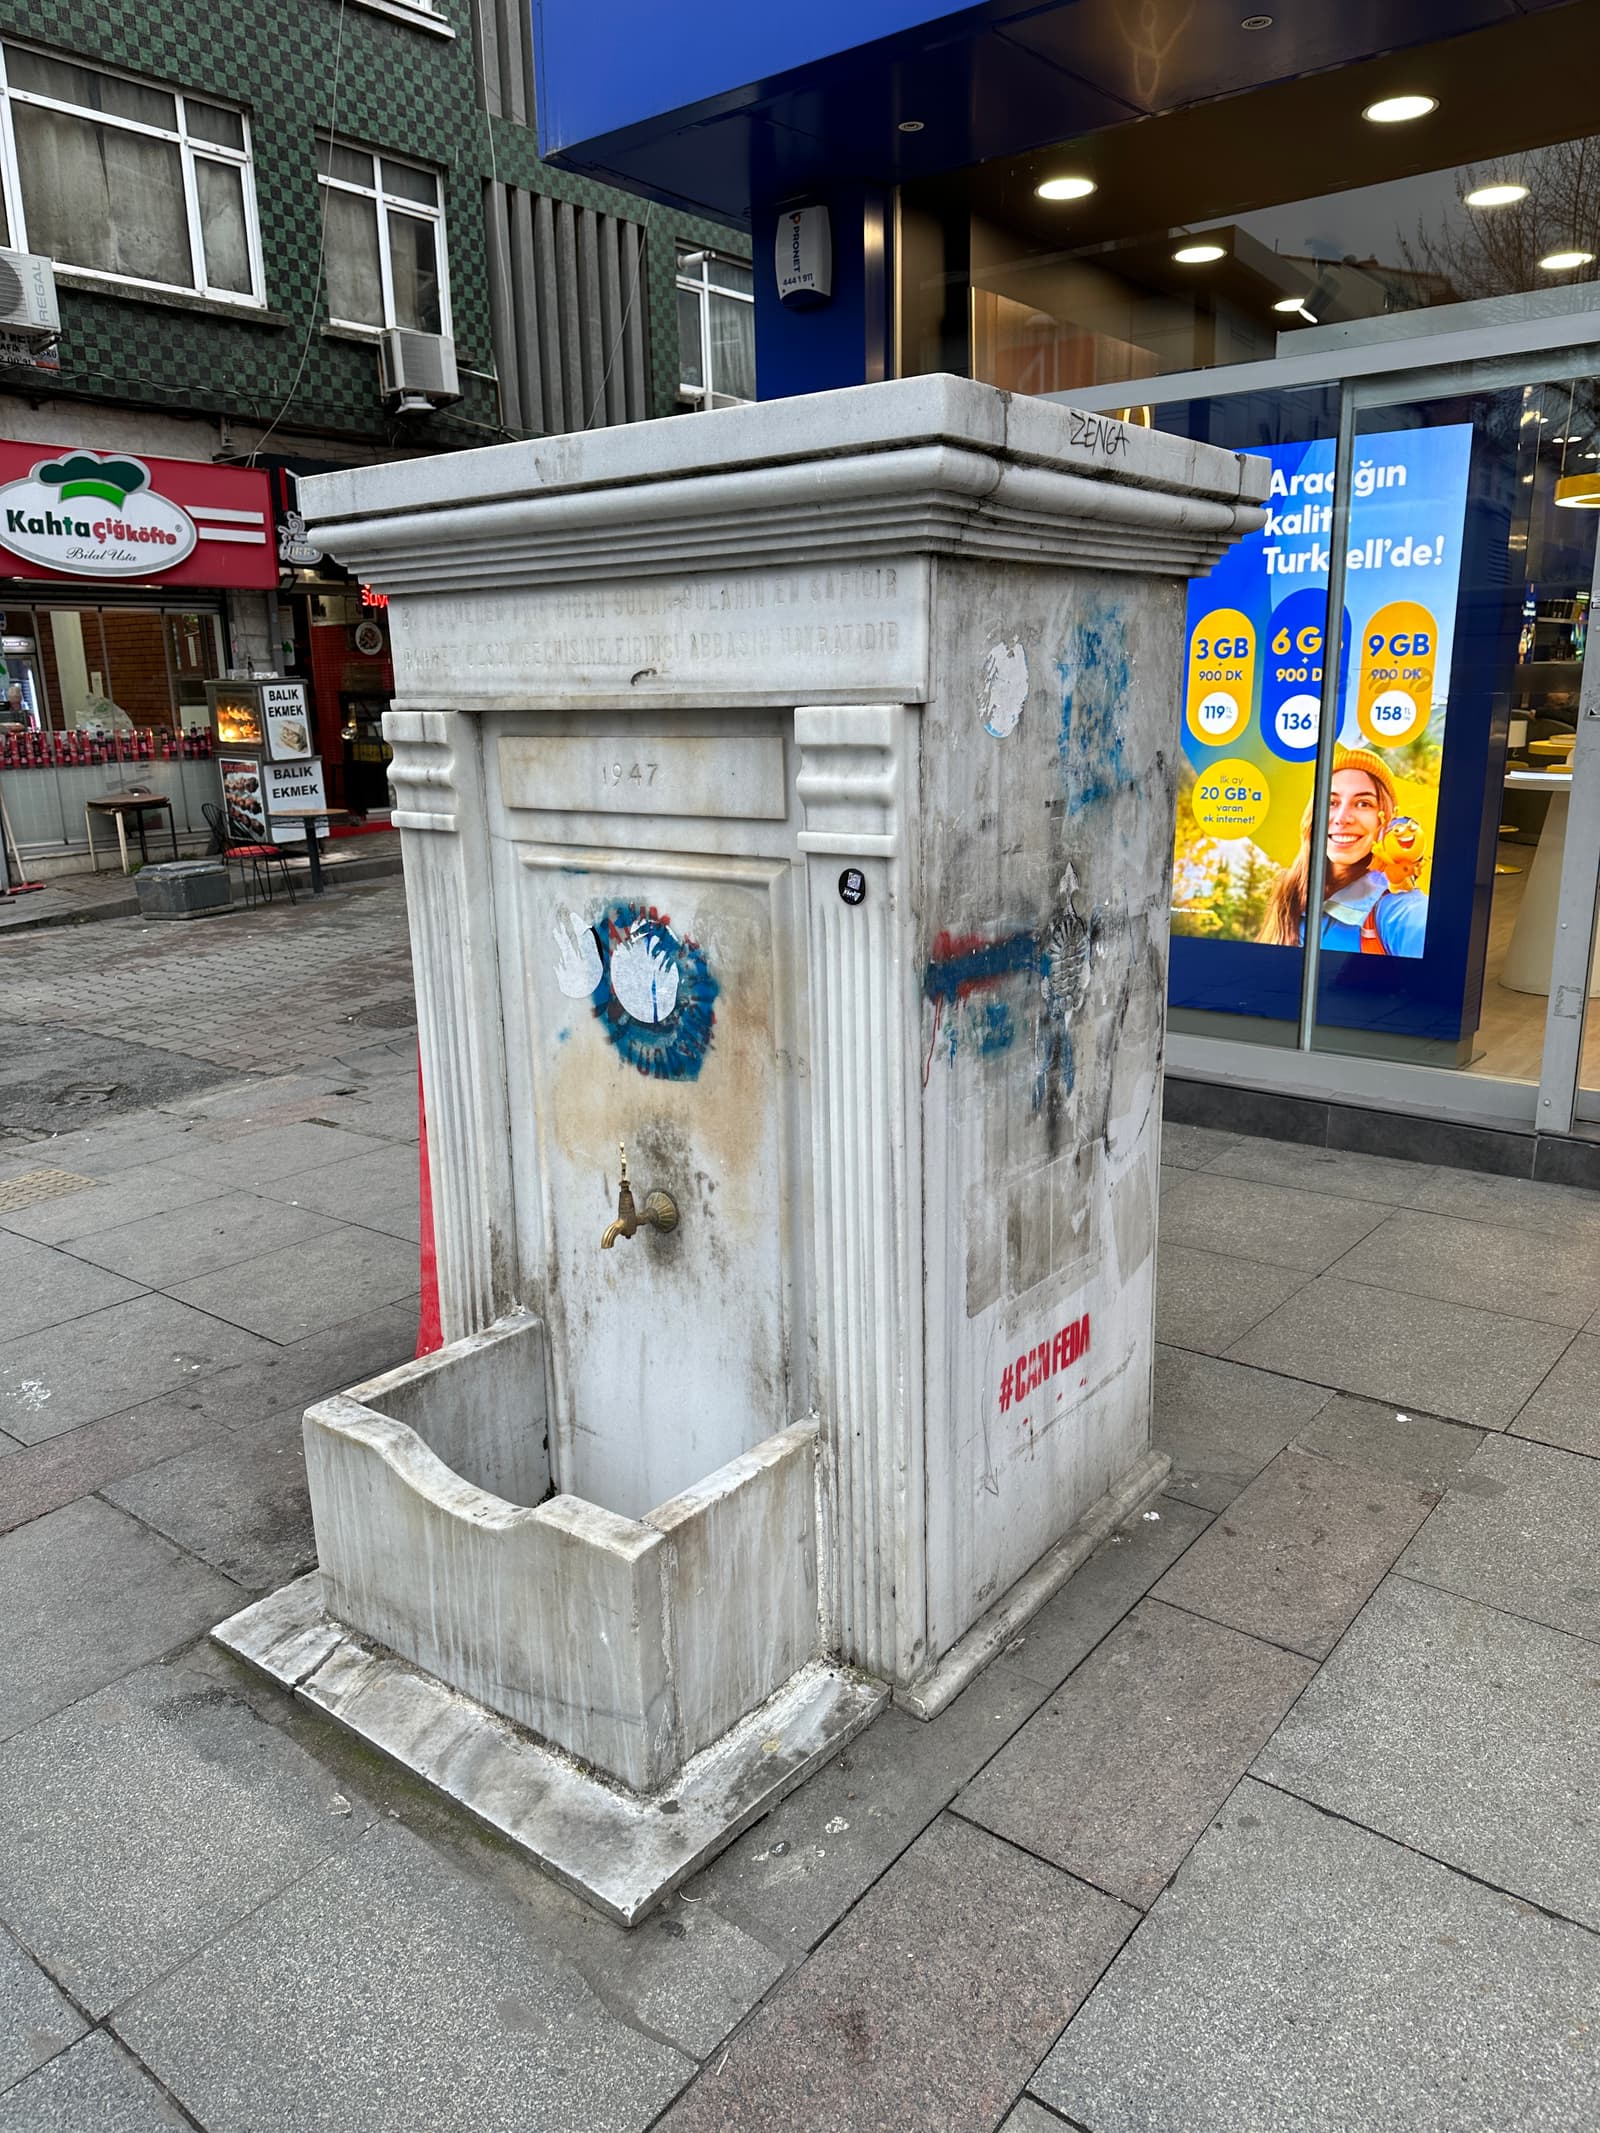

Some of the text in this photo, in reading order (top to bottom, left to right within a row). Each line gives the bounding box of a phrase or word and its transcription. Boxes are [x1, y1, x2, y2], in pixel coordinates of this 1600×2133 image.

[792, 225, 801, 273] PRONET
[783, 276, 797, 286] 444
[32, 261, 49, 322] REGAL
[1070, 411, 1131, 457] ZENGA
[1270, 459, 1407, 497] Arağın
[6, 508, 91, 538] Kahta
[1263, 504, 1351, 537] kalit
[66, 547, 138, 562] Bilal Usta
[1262, 535, 1445, 576] Turkell'de!
[1196, 637, 1249, 660] 3 GB
[1271, 626, 1292, 656] 6
[1368, 633, 1430, 657] 9 GB
[1199, 670, 1243, 681] 900 DK
[1275, 668, 1308, 682] 900
[1371, 668, 1423, 680] 900 DK
[268, 689, 299, 702] BALIK
[267, 705, 304, 718] EKMEK
[1204, 705, 1226, 719] 119
[1375, 706, 1402, 721] 158
[1281, 712, 1312, 731] 136
[273, 766, 314, 780] BALIK
[602, 763, 659, 787] 1947
[272, 784, 320, 799] EKMEK
[1200, 786, 1220, 800] 20
[1216, 805, 1244, 813] varan
[1203, 814, 1256, 824] ek internet!
